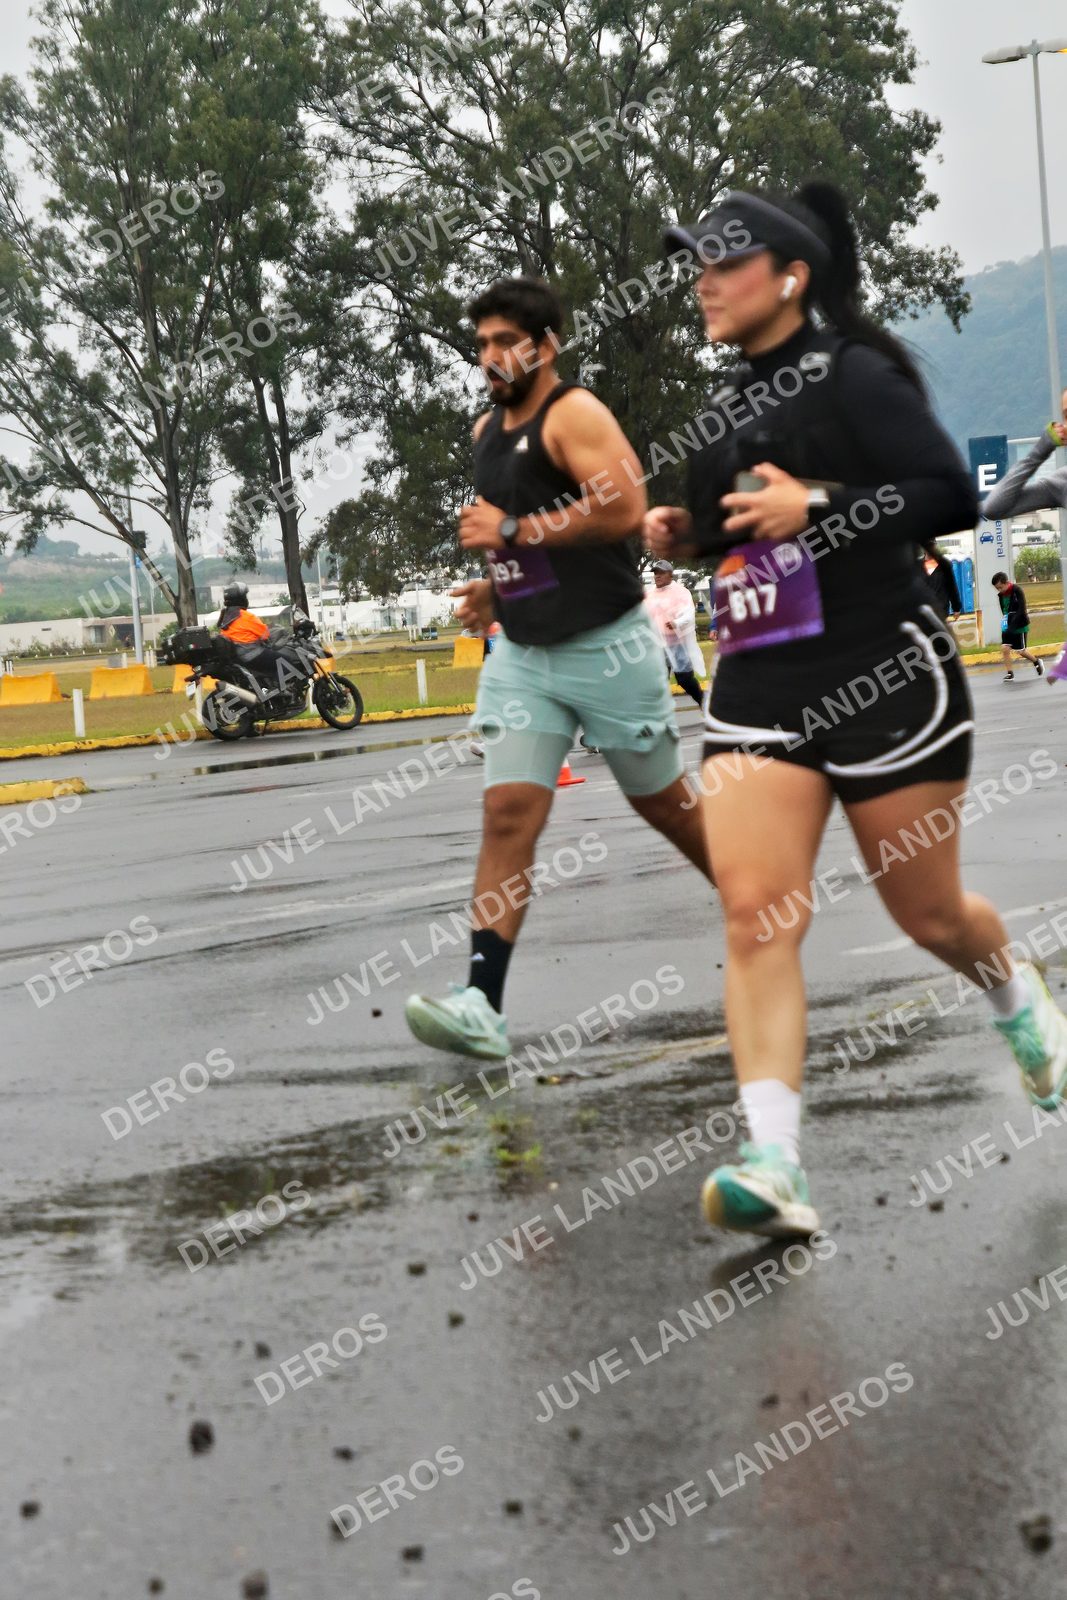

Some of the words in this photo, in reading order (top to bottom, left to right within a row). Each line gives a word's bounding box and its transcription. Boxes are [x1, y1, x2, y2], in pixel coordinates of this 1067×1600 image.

[978, 463, 998, 491] E
[995, 520, 1005, 557] eneral
[730, 583, 777, 621] 817
